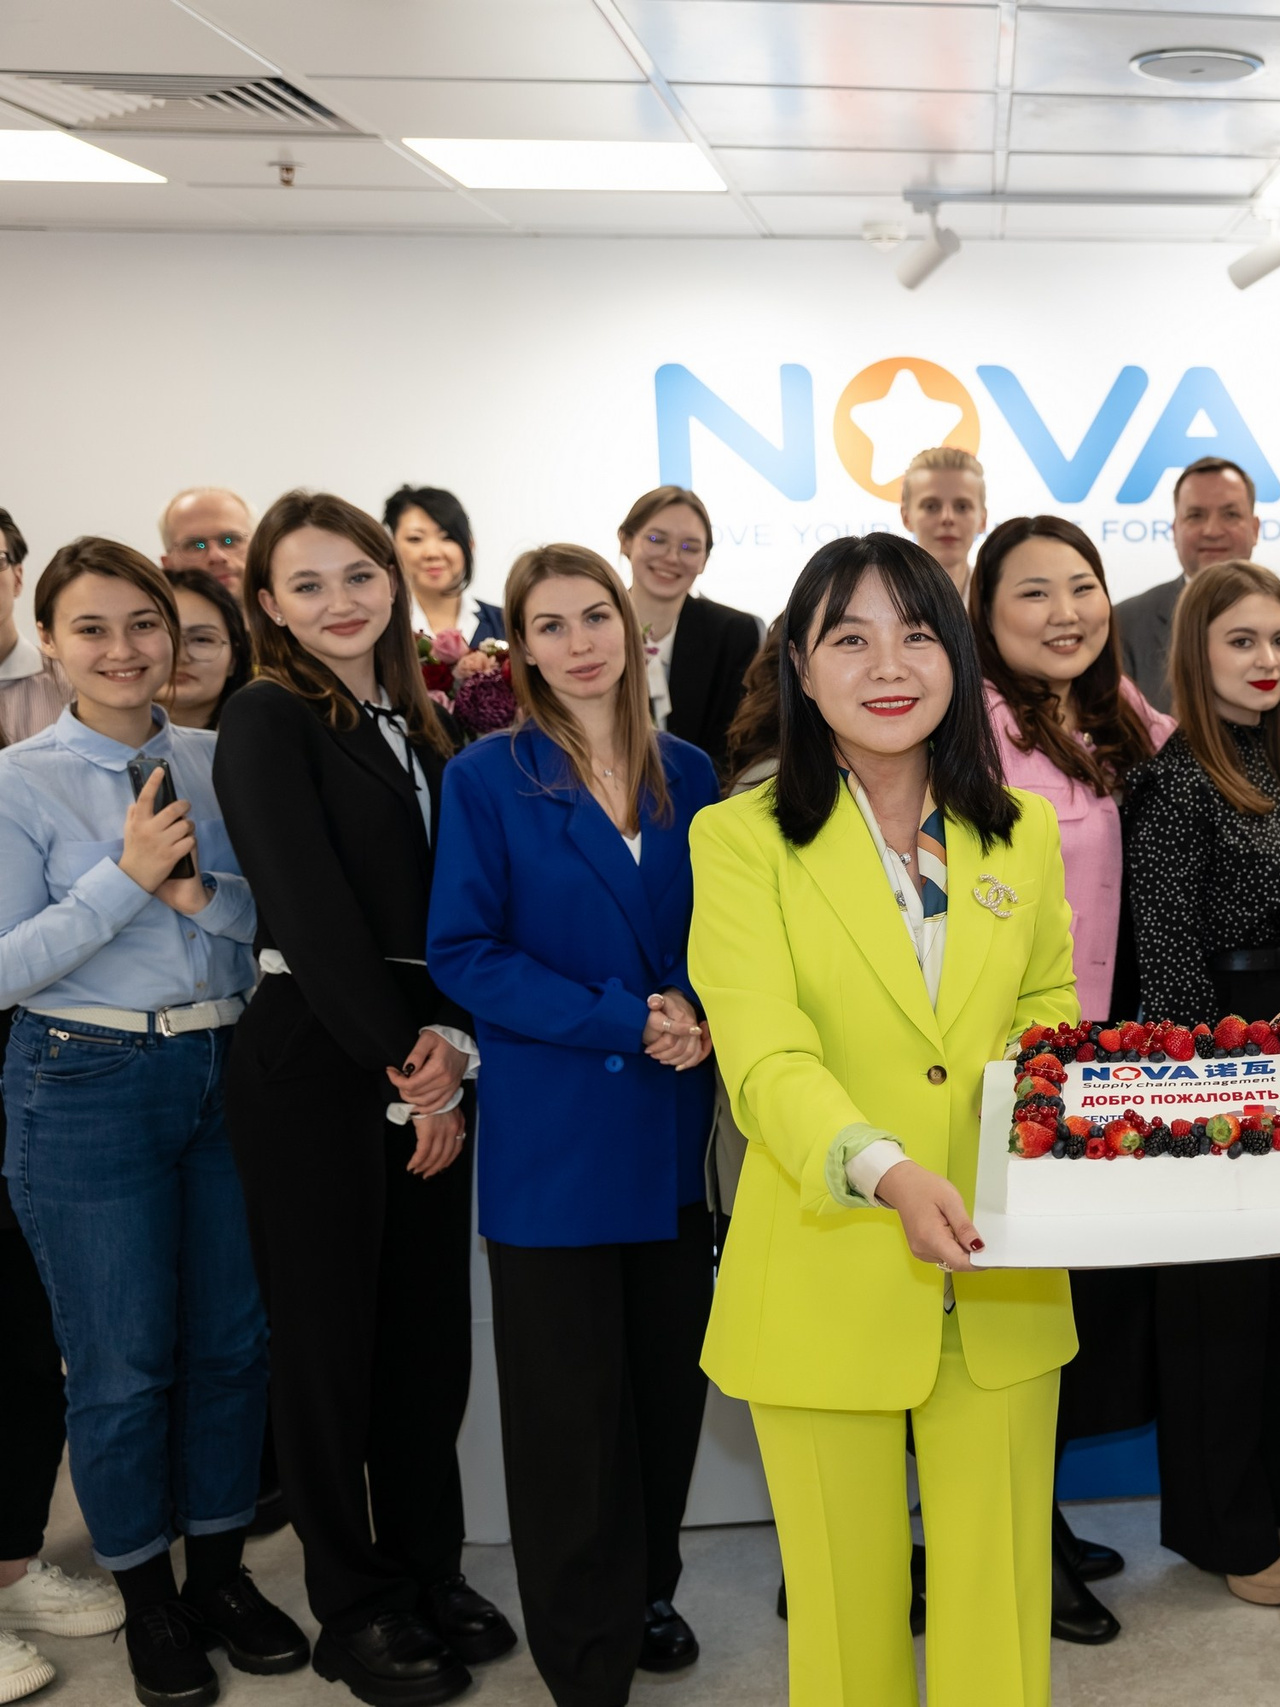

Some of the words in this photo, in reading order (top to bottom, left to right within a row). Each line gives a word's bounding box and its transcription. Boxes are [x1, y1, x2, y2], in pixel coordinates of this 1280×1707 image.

[1082, 1065, 1199, 1081] NOVA
[1204, 1060, 1276, 1079] 诺瓦
[1083, 1081, 1133, 1090] Supply
[1180, 1076, 1276, 1087] management
[1081, 1094, 1145, 1108] ДОБРО
[1150, 1089, 1280, 1105] ПОЖАЛОВАТЬ
